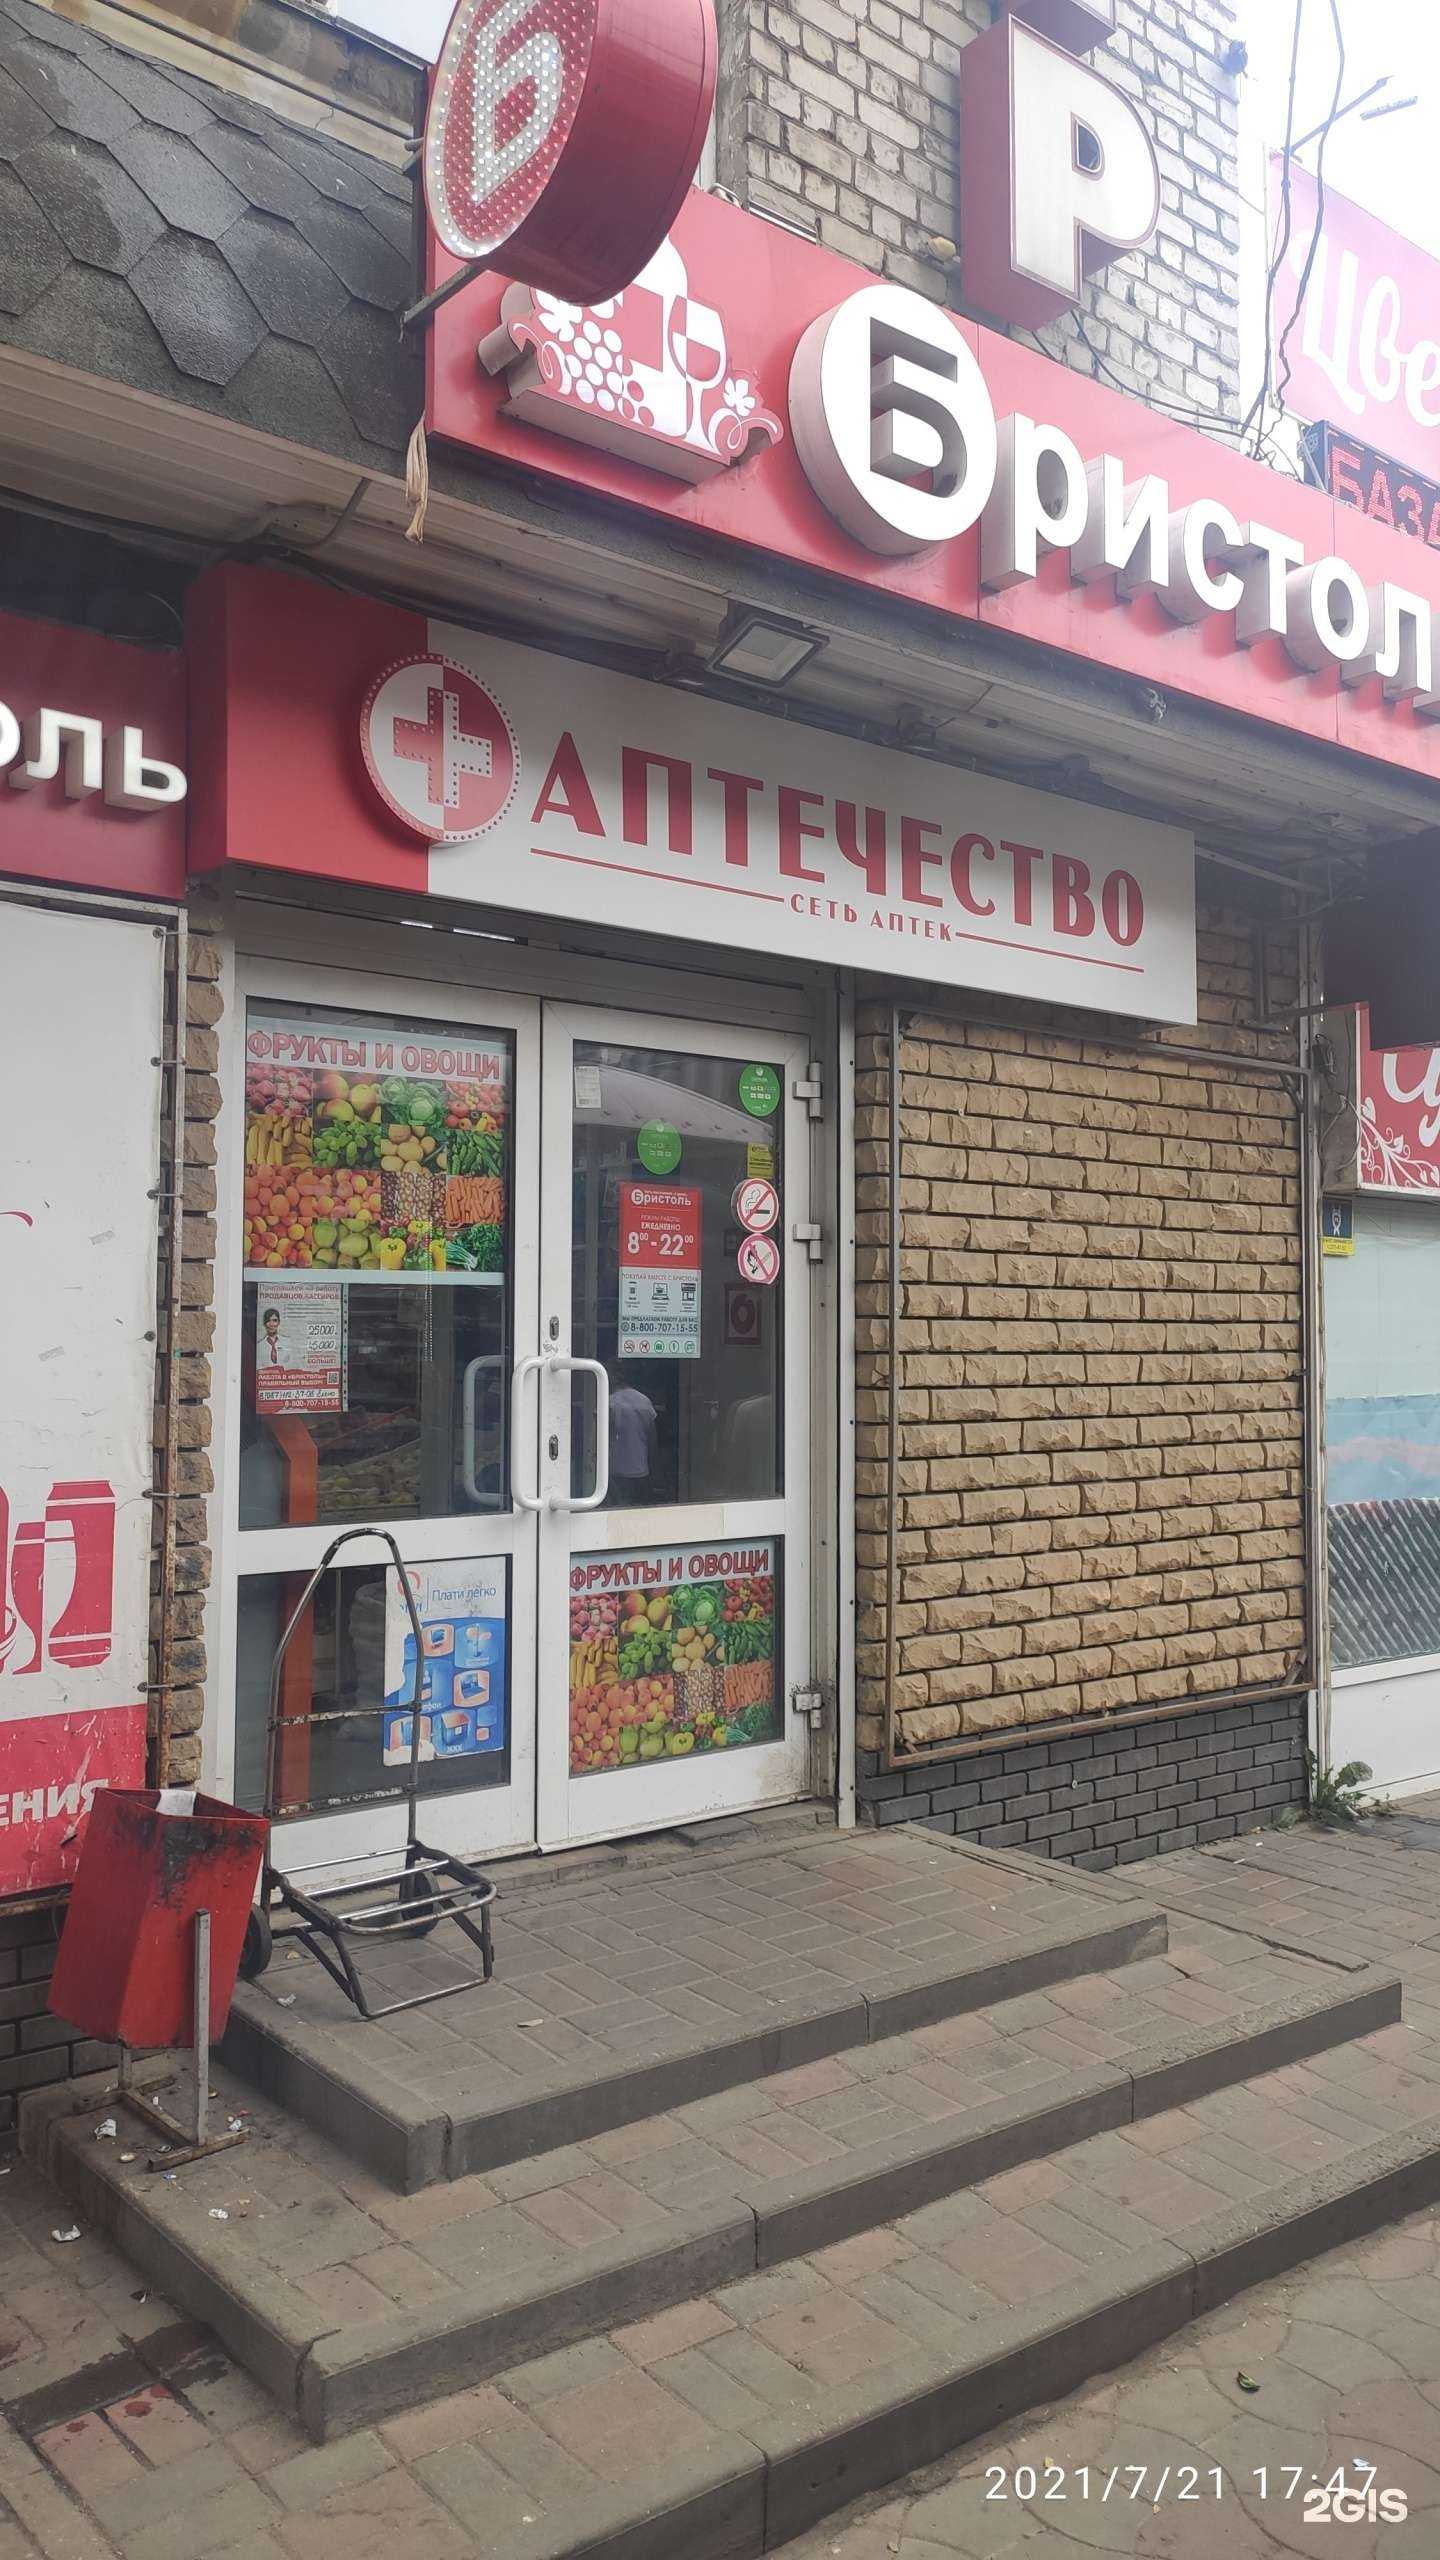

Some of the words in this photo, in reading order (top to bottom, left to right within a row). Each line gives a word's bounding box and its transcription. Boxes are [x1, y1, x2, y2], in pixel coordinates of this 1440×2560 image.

[0, 700, 187, 803] ль
[530, 730, 1145, 947] АПТЕЧЕСТВО
[790, 892, 859, 925] СЕТЬ
[869, 908, 954, 943] АПТЕК
[247, 1030, 367, 1068] ФРУКТЫ
[374, 1042, 394, 1070] И
[400, 1046, 500, 1082] ОВОЩИ
[631, 1188, 692, 1206] Бристоль
[631, 1323, 698, 1333] 8-800-707-15-55
[570, 1560, 662, 1591] ФРУКТЫ
[668, 1556, 683, 1580] И
[688, 1549, 769, 1579] ОВОЩИ
[432, 1589, 465, 1602] Плати
